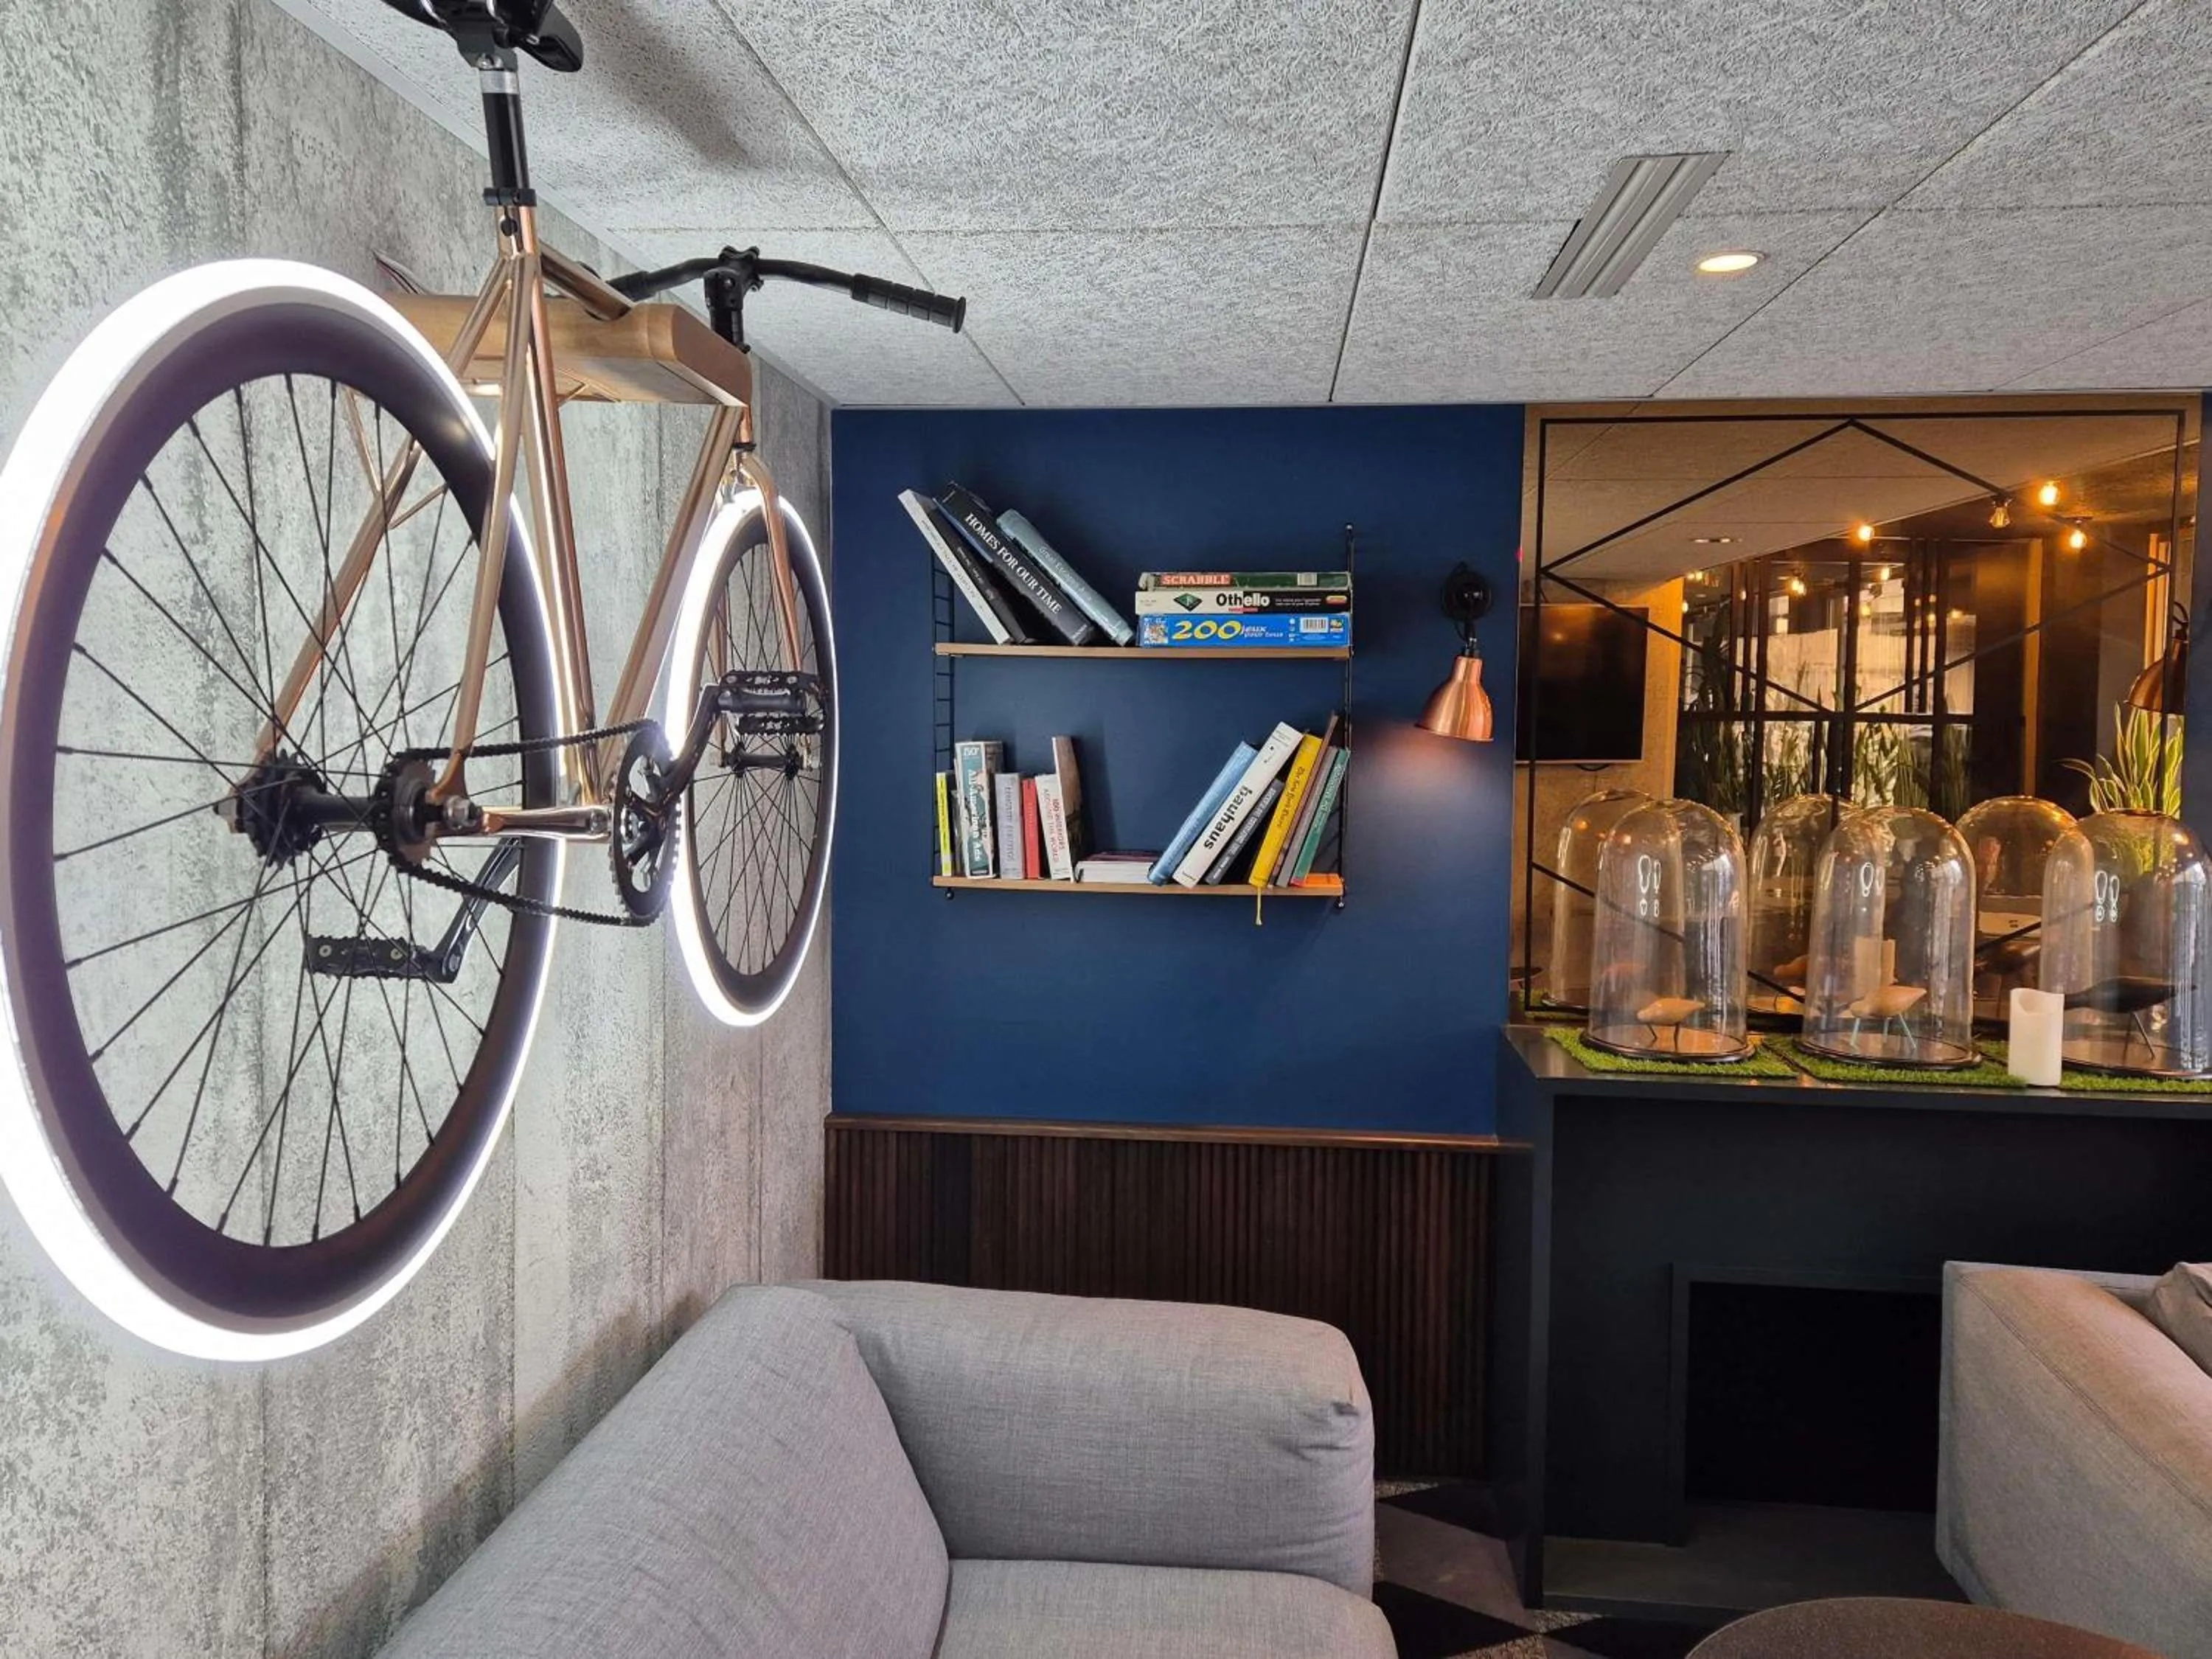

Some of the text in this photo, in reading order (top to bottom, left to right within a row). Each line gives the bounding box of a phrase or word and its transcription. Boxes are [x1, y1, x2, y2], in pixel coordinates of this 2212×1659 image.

[965, 513, 1000, 549] HOMES
[998, 546, 1018, 568] FOR
[1016, 566, 1039, 589] OUR
[1035, 586, 1062, 614] TIME
[1163, 574, 1230, 585] SCRABBLE
[1217, 593, 1270, 607] Othello
[1172, 620, 1242, 639] 200
[1203, 785, 1253, 850] bauhaus
